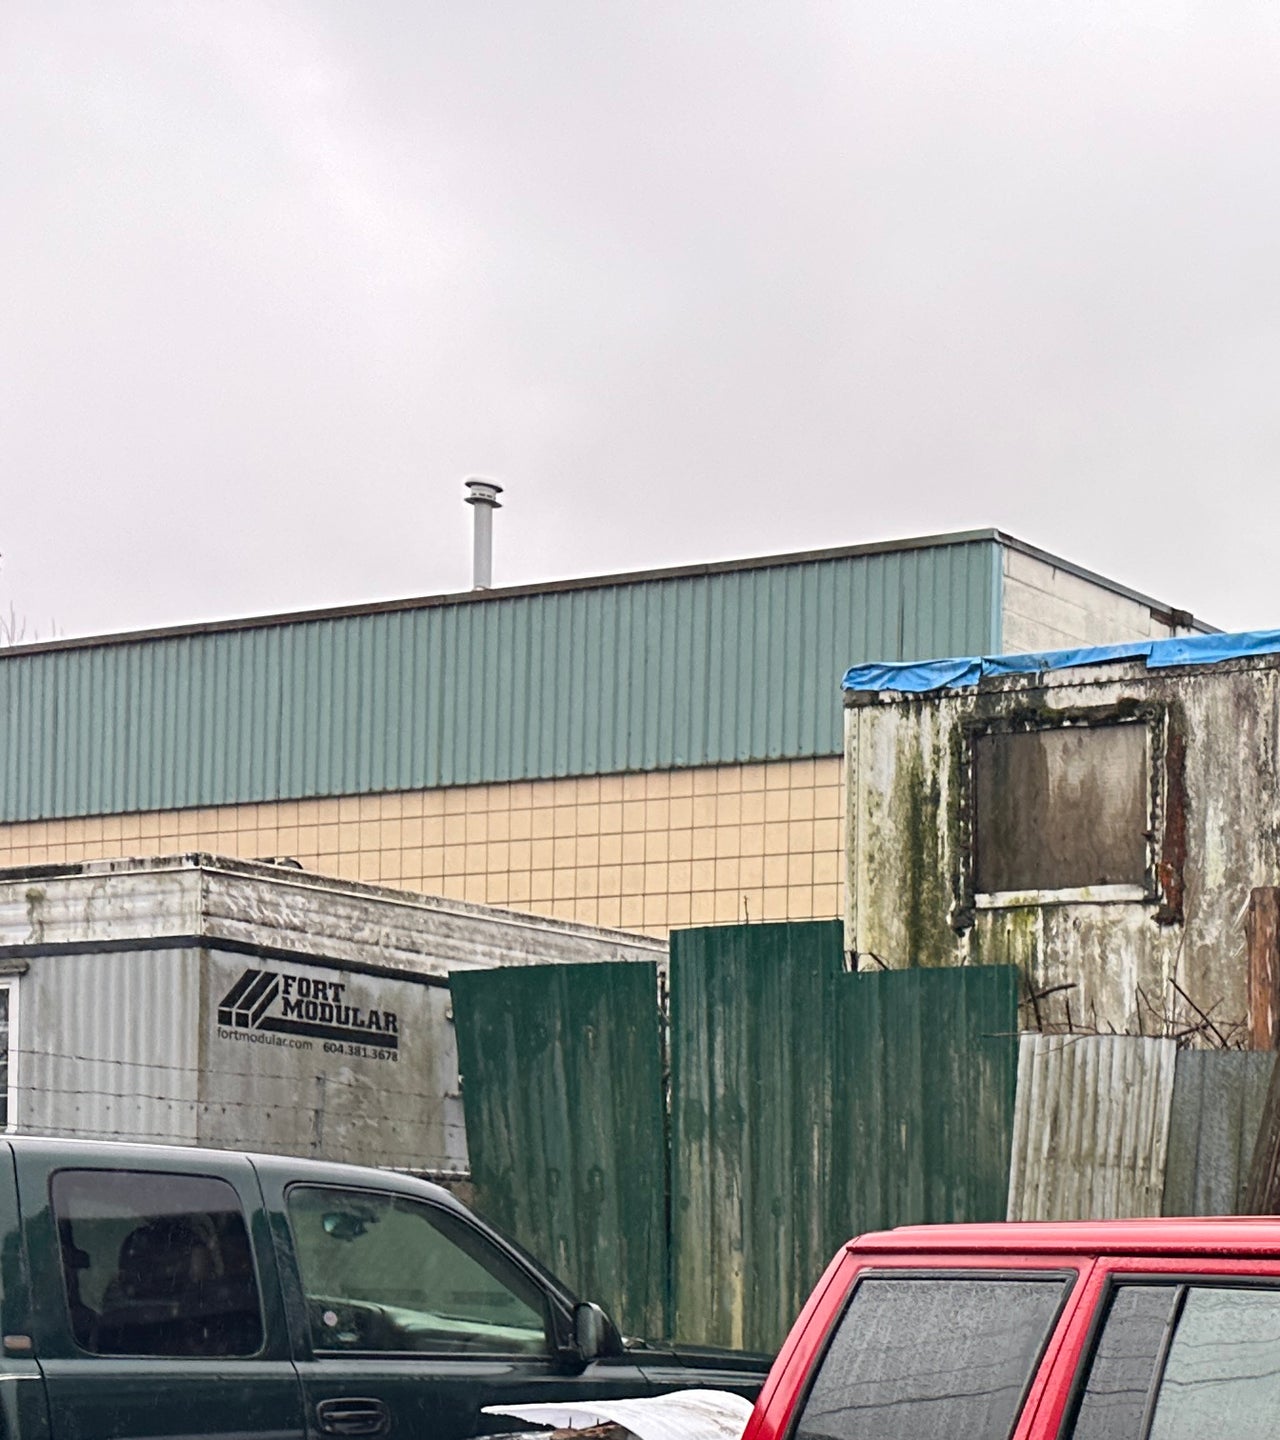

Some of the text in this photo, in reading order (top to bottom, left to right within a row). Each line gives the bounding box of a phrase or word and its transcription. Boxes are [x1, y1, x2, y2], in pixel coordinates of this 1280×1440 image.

[281, 973, 345, 1003] FORT
[281, 996, 399, 1034] MODULAR
[217, 1027, 399, 1062] fortmodular.com 604.381.3678
